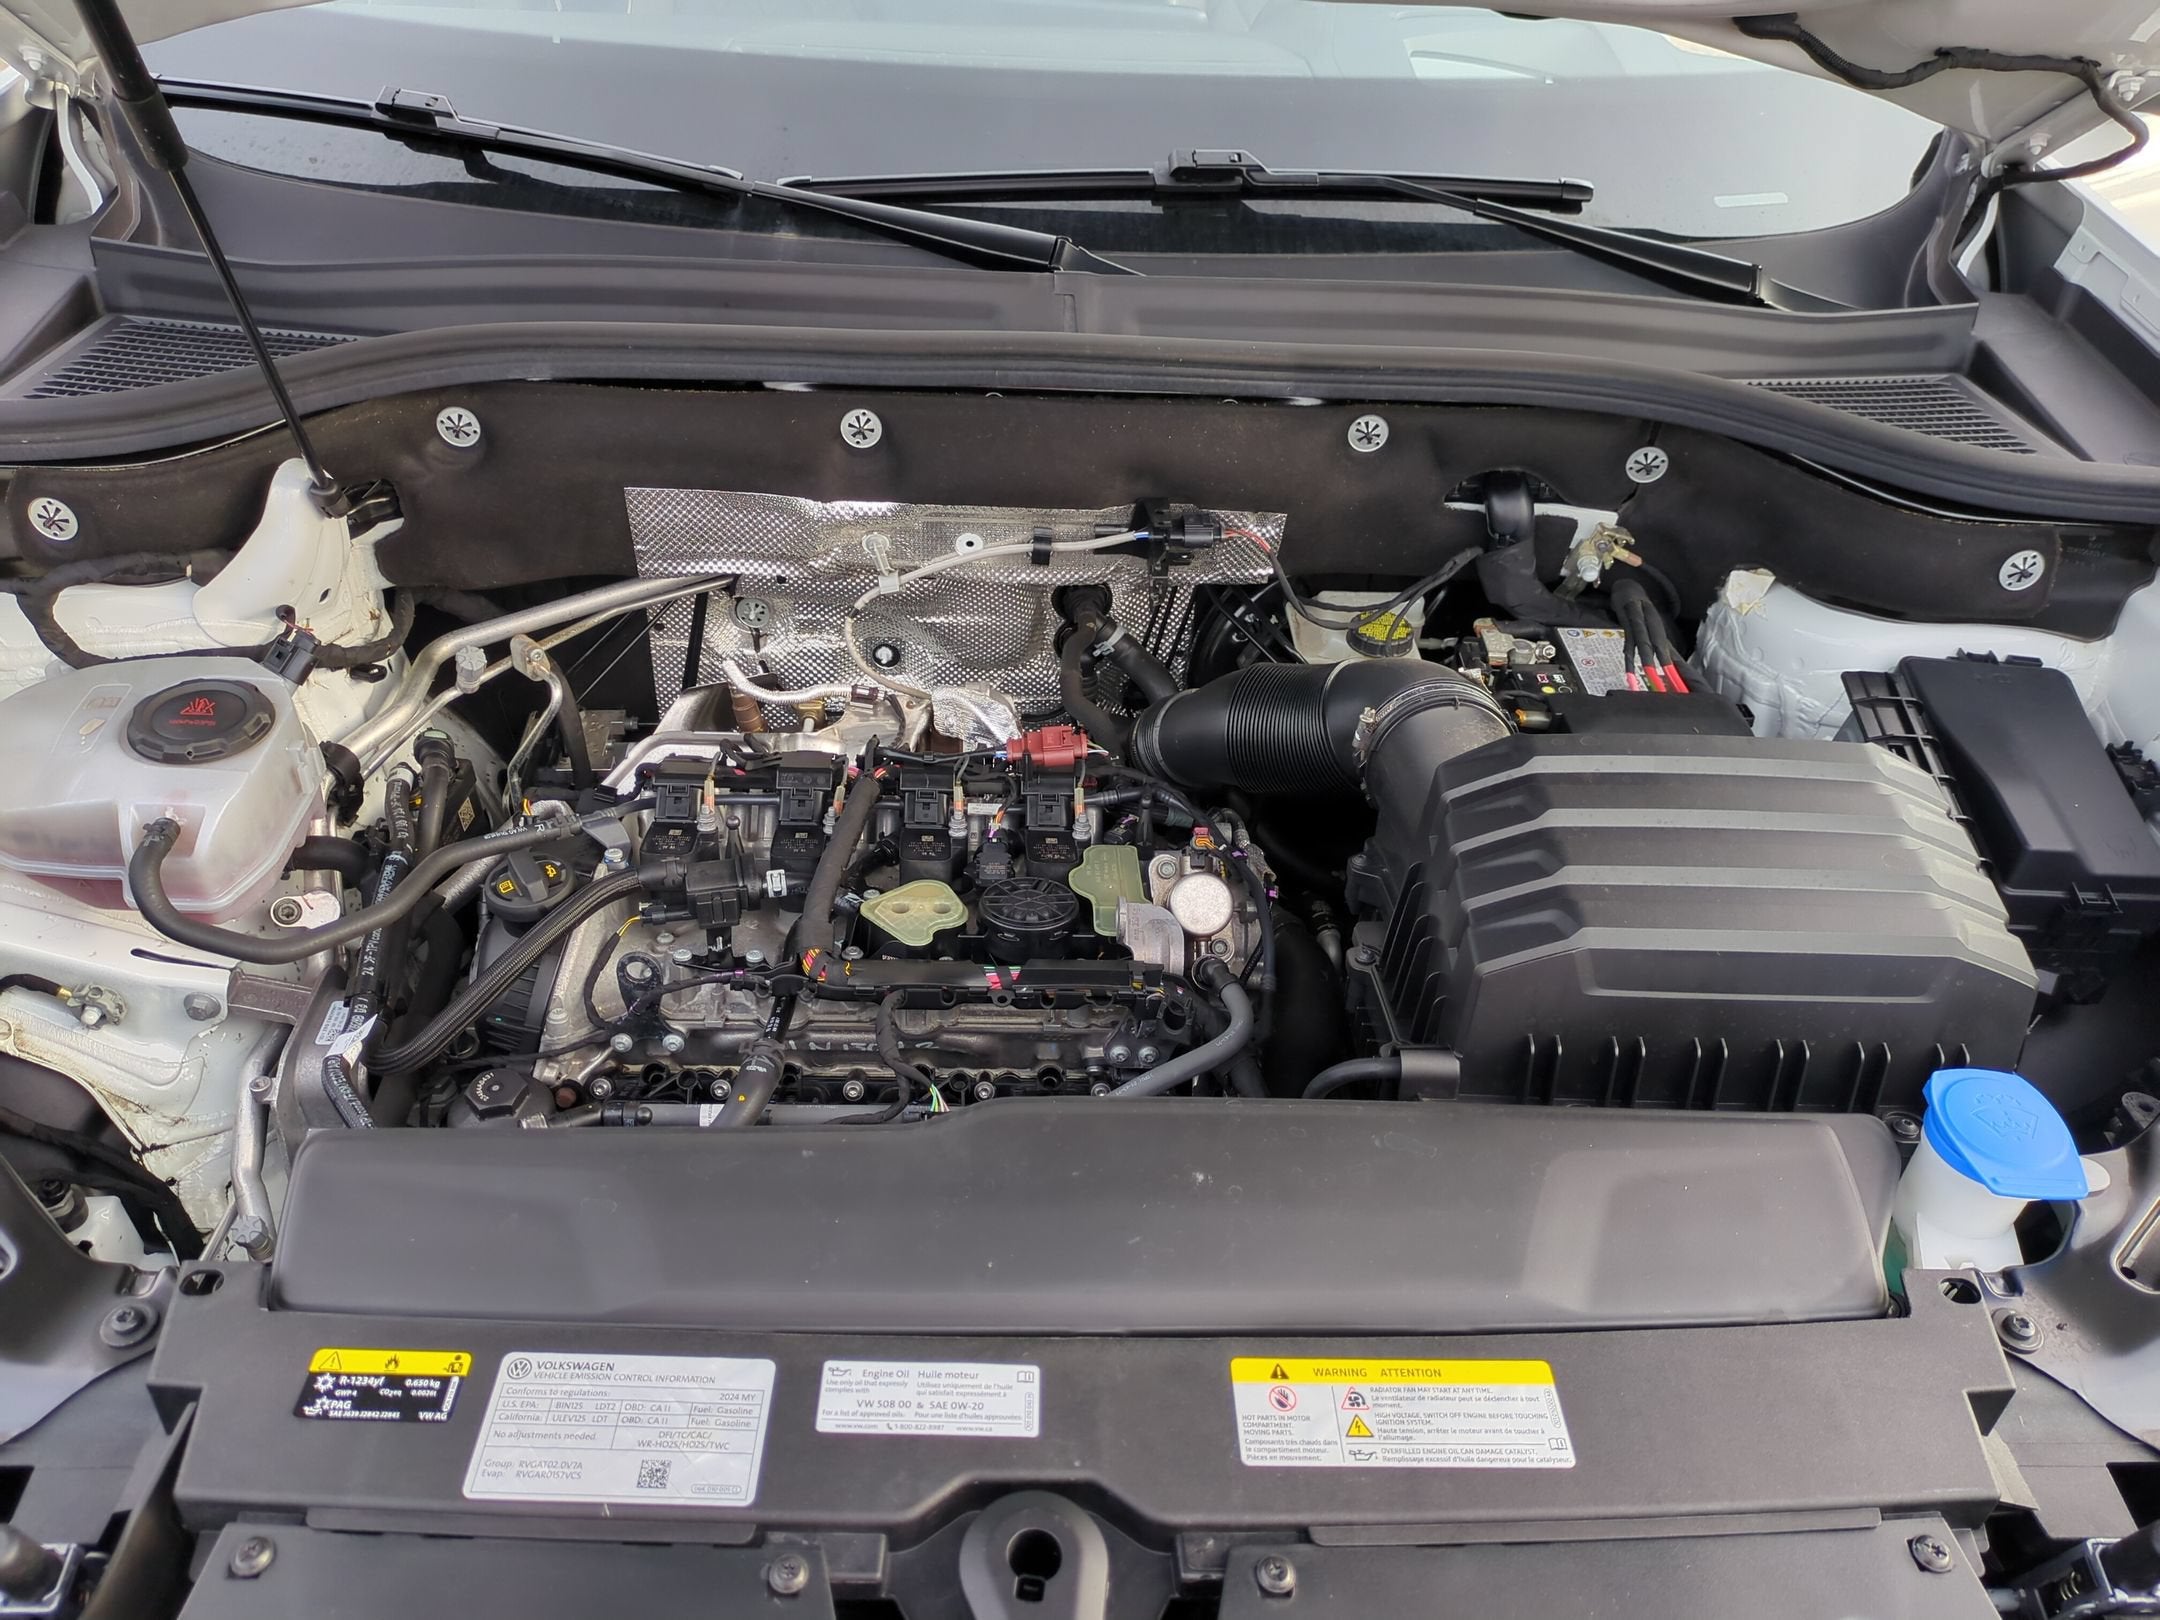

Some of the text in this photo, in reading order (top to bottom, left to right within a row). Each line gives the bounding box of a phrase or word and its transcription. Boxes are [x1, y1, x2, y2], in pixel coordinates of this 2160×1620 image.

[537, 1361, 615, 1372] VOLKSWAGEN
[534, 1372, 716, 1384] VEHICLE EMISSION CONTROL INFORMATION
[862, 1369, 894, 1380] Engine
[896, 1370, 910, 1378] Oil
[918, 1370, 943, 1379] Huile
[1312, 1368, 1442, 1378] WARNING ATTENTION
[339, 1375, 441, 1389] R-1234yf 0.650 kg
[506, 1388, 548, 1396] Conforms
[549, 1388, 559, 1396] to
[719, 1393, 756, 1401] 2024 MY
[330, 1400, 352, 1409] PAG
[856, 1400, 875, 1408] VW
[878, 1400, 895, 1408] 508
[898, 1400, 912, 1408] 00
[930, 1401, 948, 1409] SAE
[950, 1401, 984, 1410] 0W-20
[418, 1411, 447, 1421] VW AG
[691, 1418, 711, 1426] Fuel:
[493, 1430, 507, 1438] No
[508, 1431, 562, 1441] adjustments
